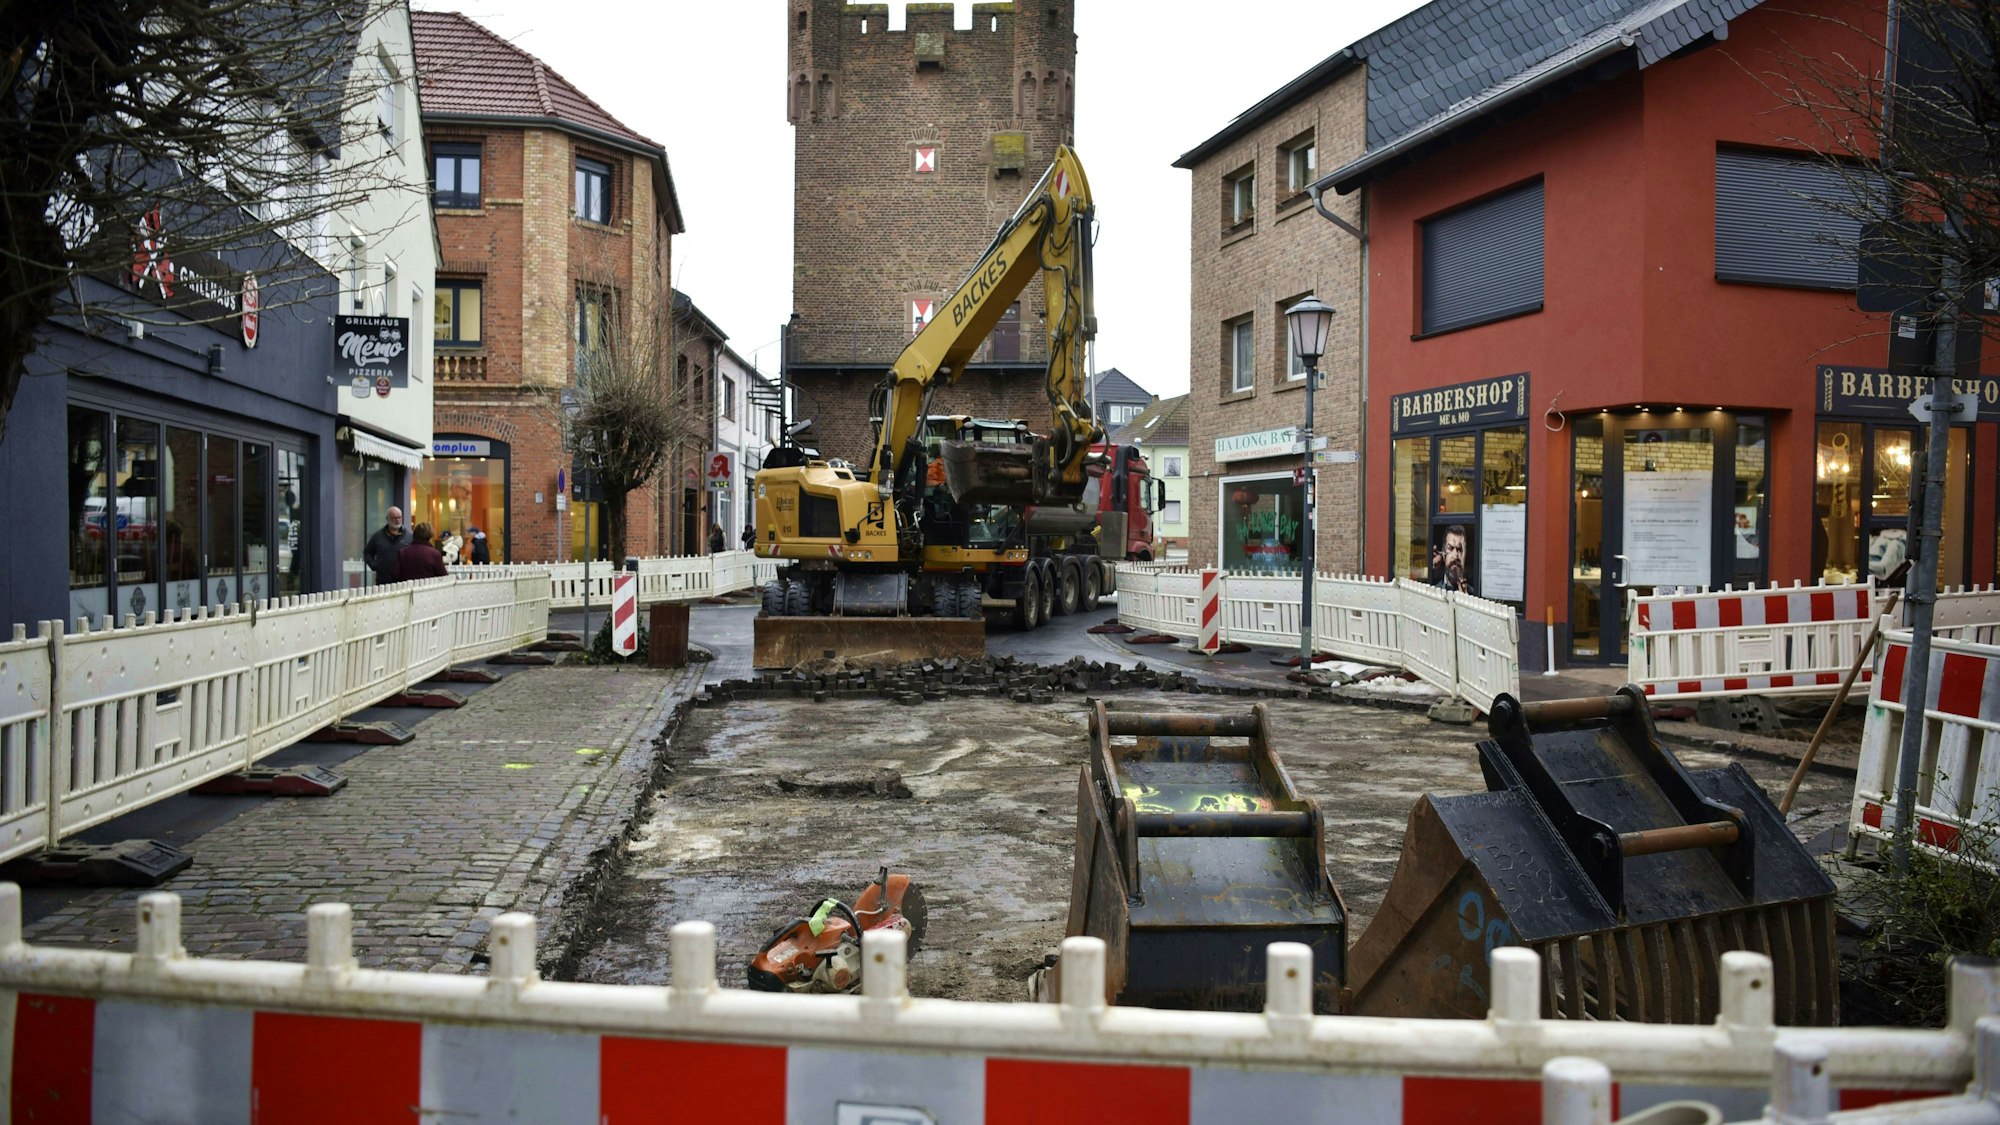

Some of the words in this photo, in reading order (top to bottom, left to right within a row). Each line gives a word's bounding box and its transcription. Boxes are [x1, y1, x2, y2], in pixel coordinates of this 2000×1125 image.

[952, 251, 1007, 328] BACKES
[345, 317, 399, 326] GRILLHAUS
[338, 331, 405, 367] Memo
[348, 368, 393, 377] PIZZERIA
[1402, 380, 1513, 417] BARBERSHOP
[1841, 371, 1999, 404] BARBESHO
[1439, 414, 1450, 425] ME
[1451, 414, 1457, 424] &
[1458, 411, 1470, 423] MO
[1217, 440, 1232, 452] HA
[1235, 434, 1267, 450] LONG
[1270, 430, 1292, 445] BAY
